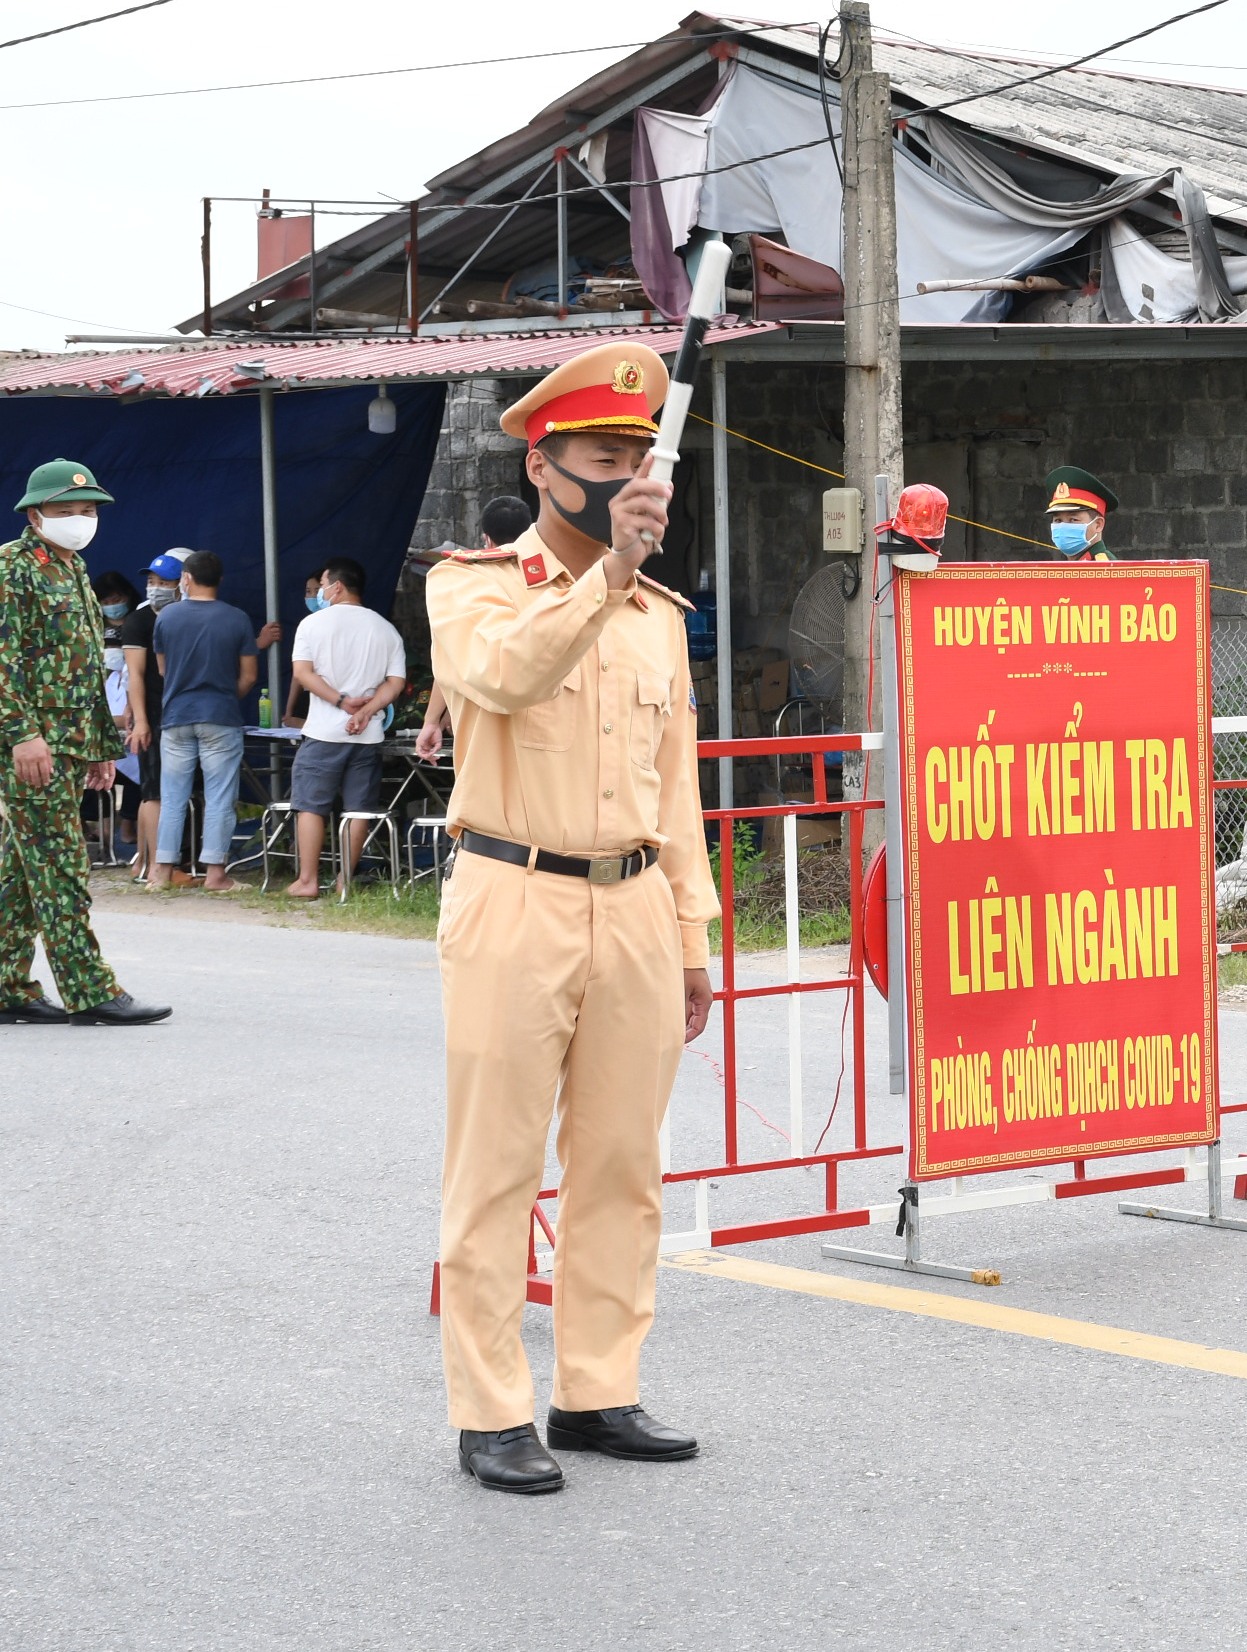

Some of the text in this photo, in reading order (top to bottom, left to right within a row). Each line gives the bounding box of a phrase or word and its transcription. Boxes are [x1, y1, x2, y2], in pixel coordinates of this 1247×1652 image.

[934, 587, 1177, 654] HUYỆN VĨNH BẢO
[926, 702, 1192, 843] CHỐT KIỂM TRA
[947, 868, 1179, 995] LIÊN NGÀNH
[930, 1019, 1200, 1134] PHÒNG, CHỐNG DỊHCH COVID-19
